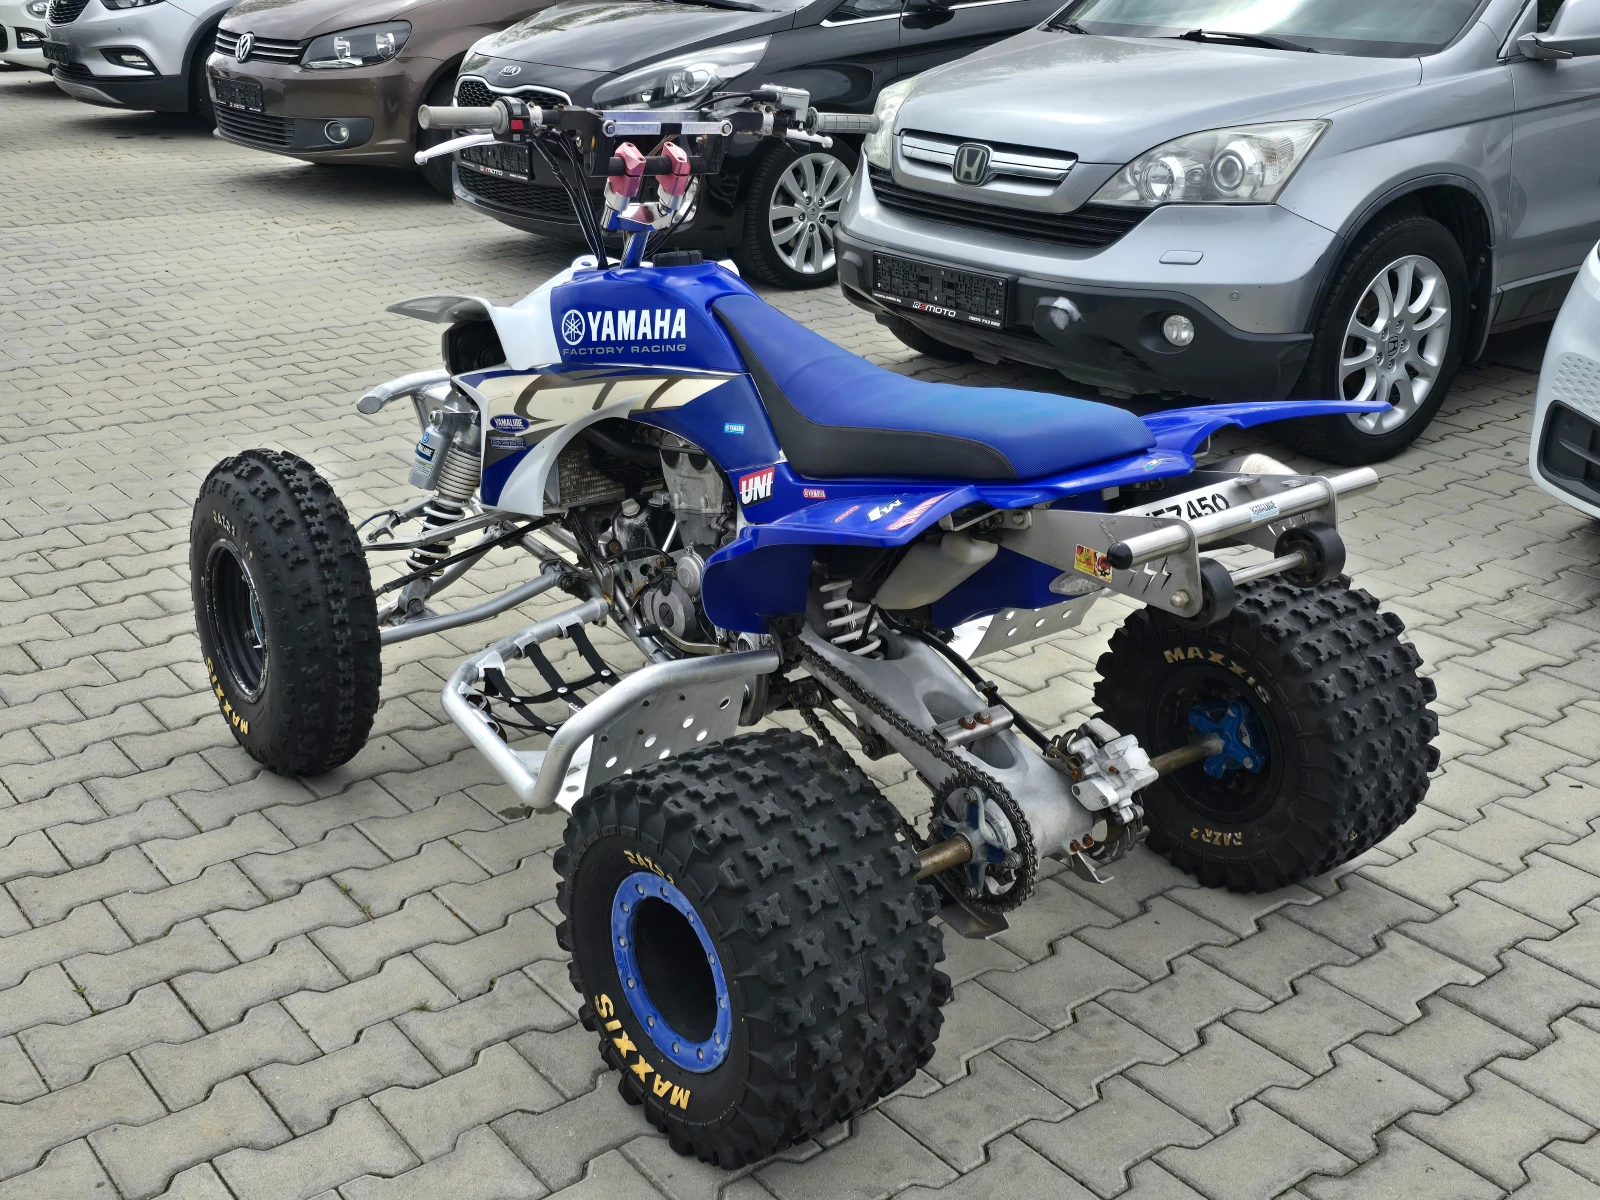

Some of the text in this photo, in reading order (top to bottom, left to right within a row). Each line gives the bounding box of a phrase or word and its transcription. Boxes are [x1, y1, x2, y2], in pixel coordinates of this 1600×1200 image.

[587, 308, 687, 342] YAMAHA
[562, 343, 687, 356] FACTORY RACING
[739, 472, 773, 505] UNI
[1163, 646, 1271, 704] MAXXIS
[206, 657, 249, 735] MAXXIS
[1189, 827, 1243, 847] RAZR 2
[594, 993, 691, 1111] MAXXIS
